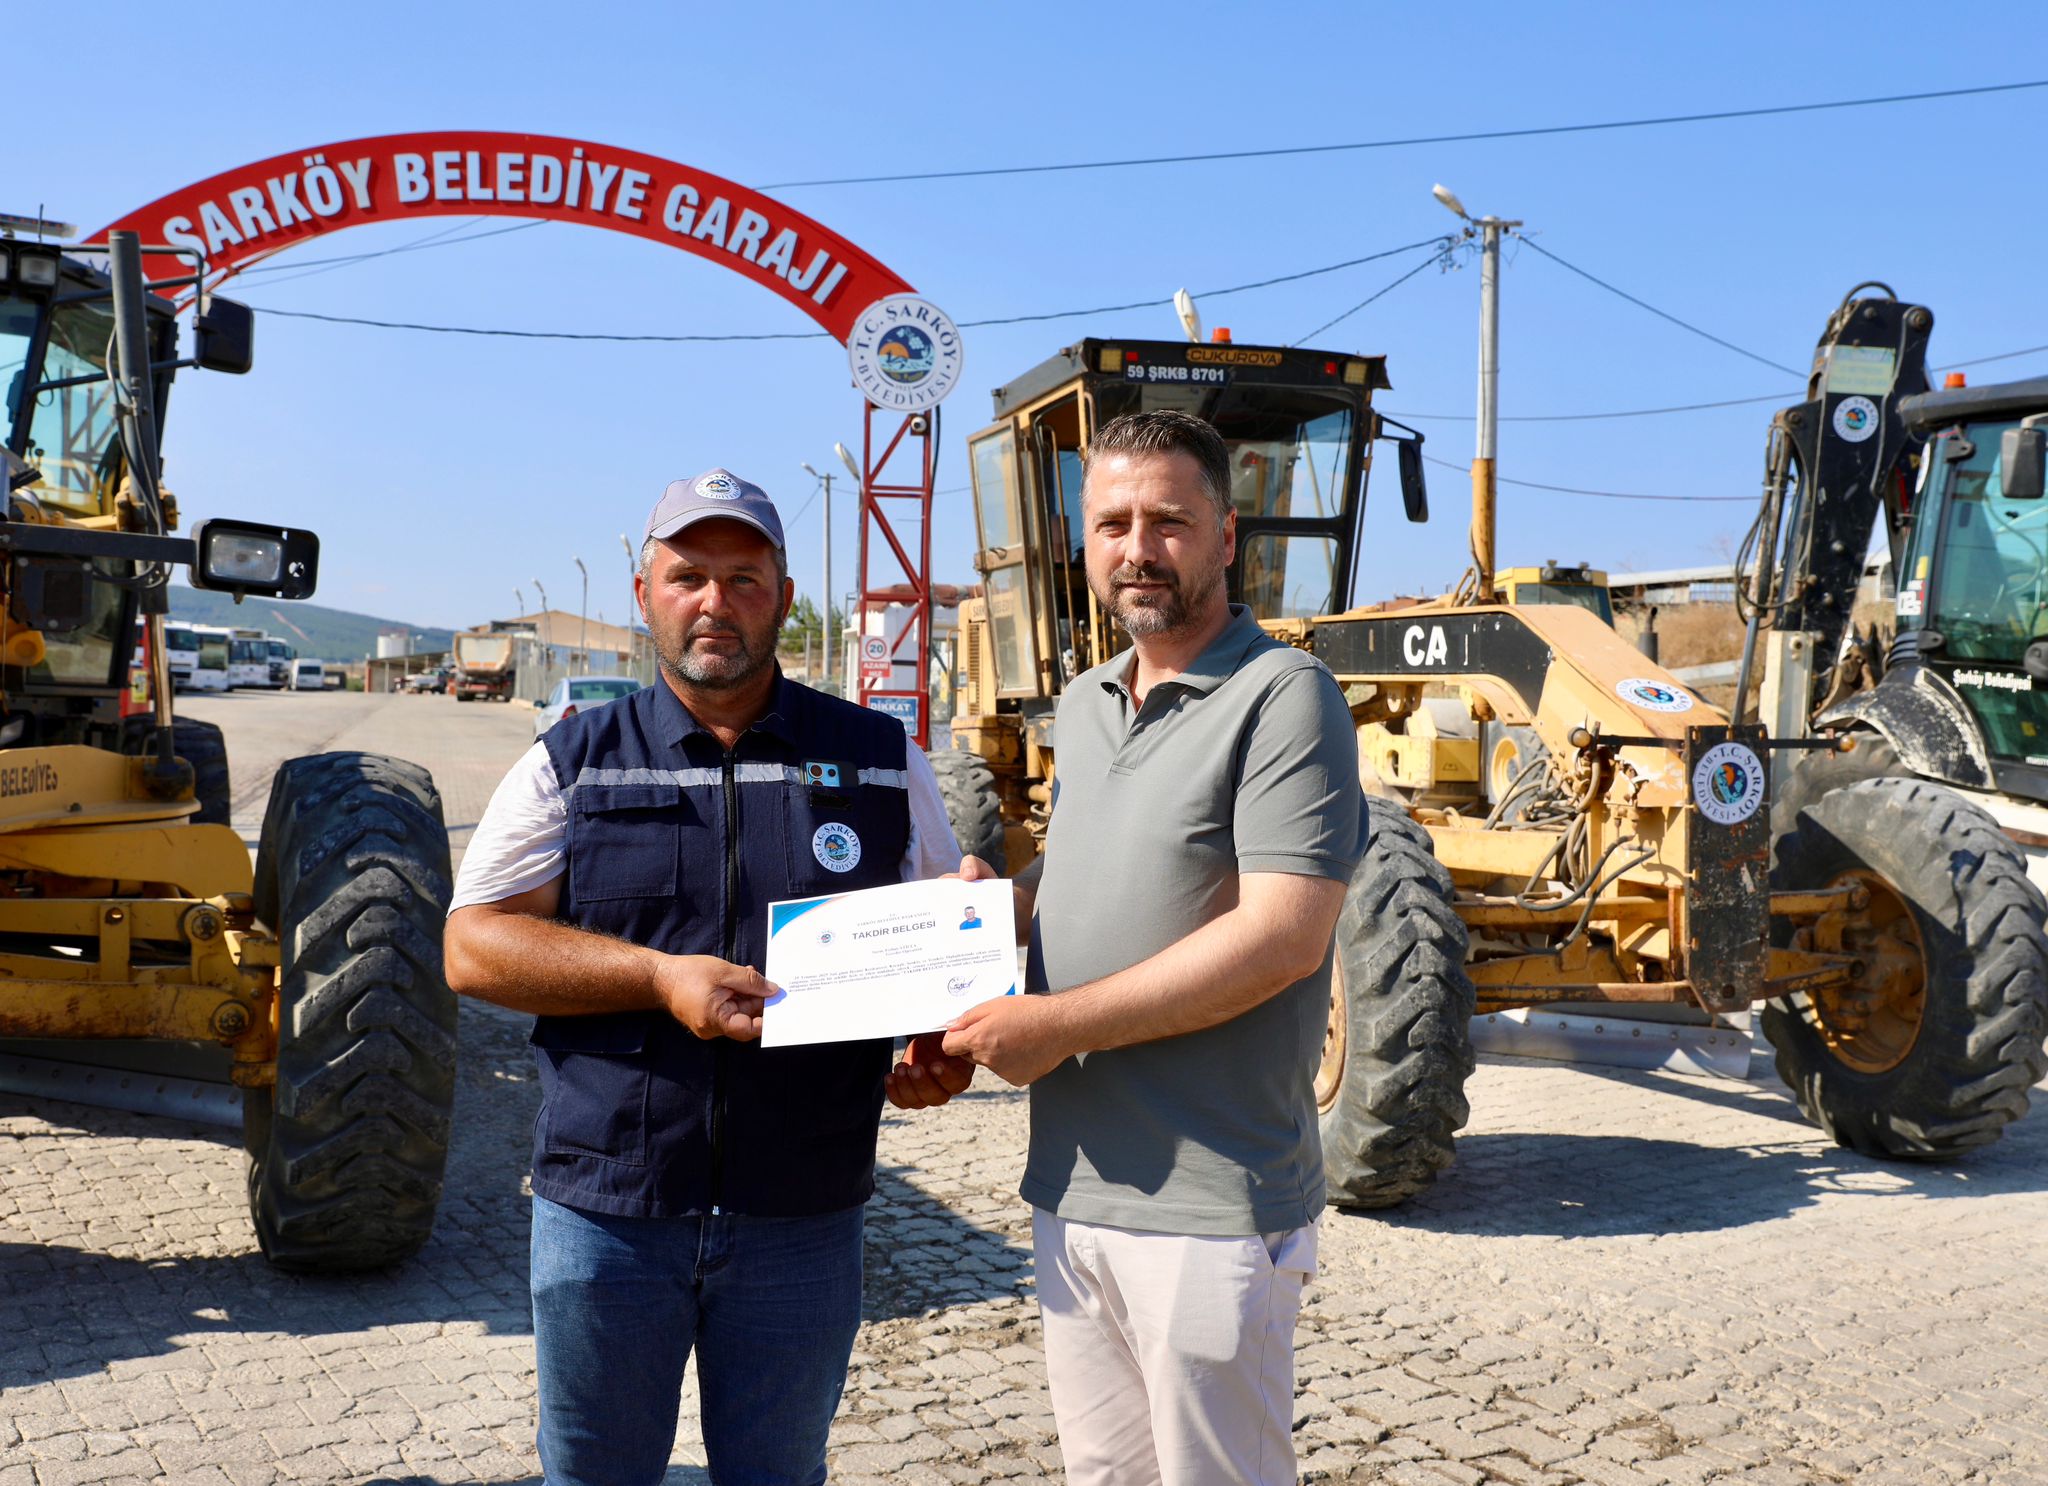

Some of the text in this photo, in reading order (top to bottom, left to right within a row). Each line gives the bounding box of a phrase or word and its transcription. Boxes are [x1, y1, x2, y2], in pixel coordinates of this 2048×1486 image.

[162, 147, 848, 305] ŞARKÖY BELEDİYE GARAJI
[1127, 365, 1224, 382] 59 ŞRKB 8701
[869, 644, 884, 653] 20
[852, 927, 890, 940] TAKDİR
[892, 919, 936, 934] BELGESİ
